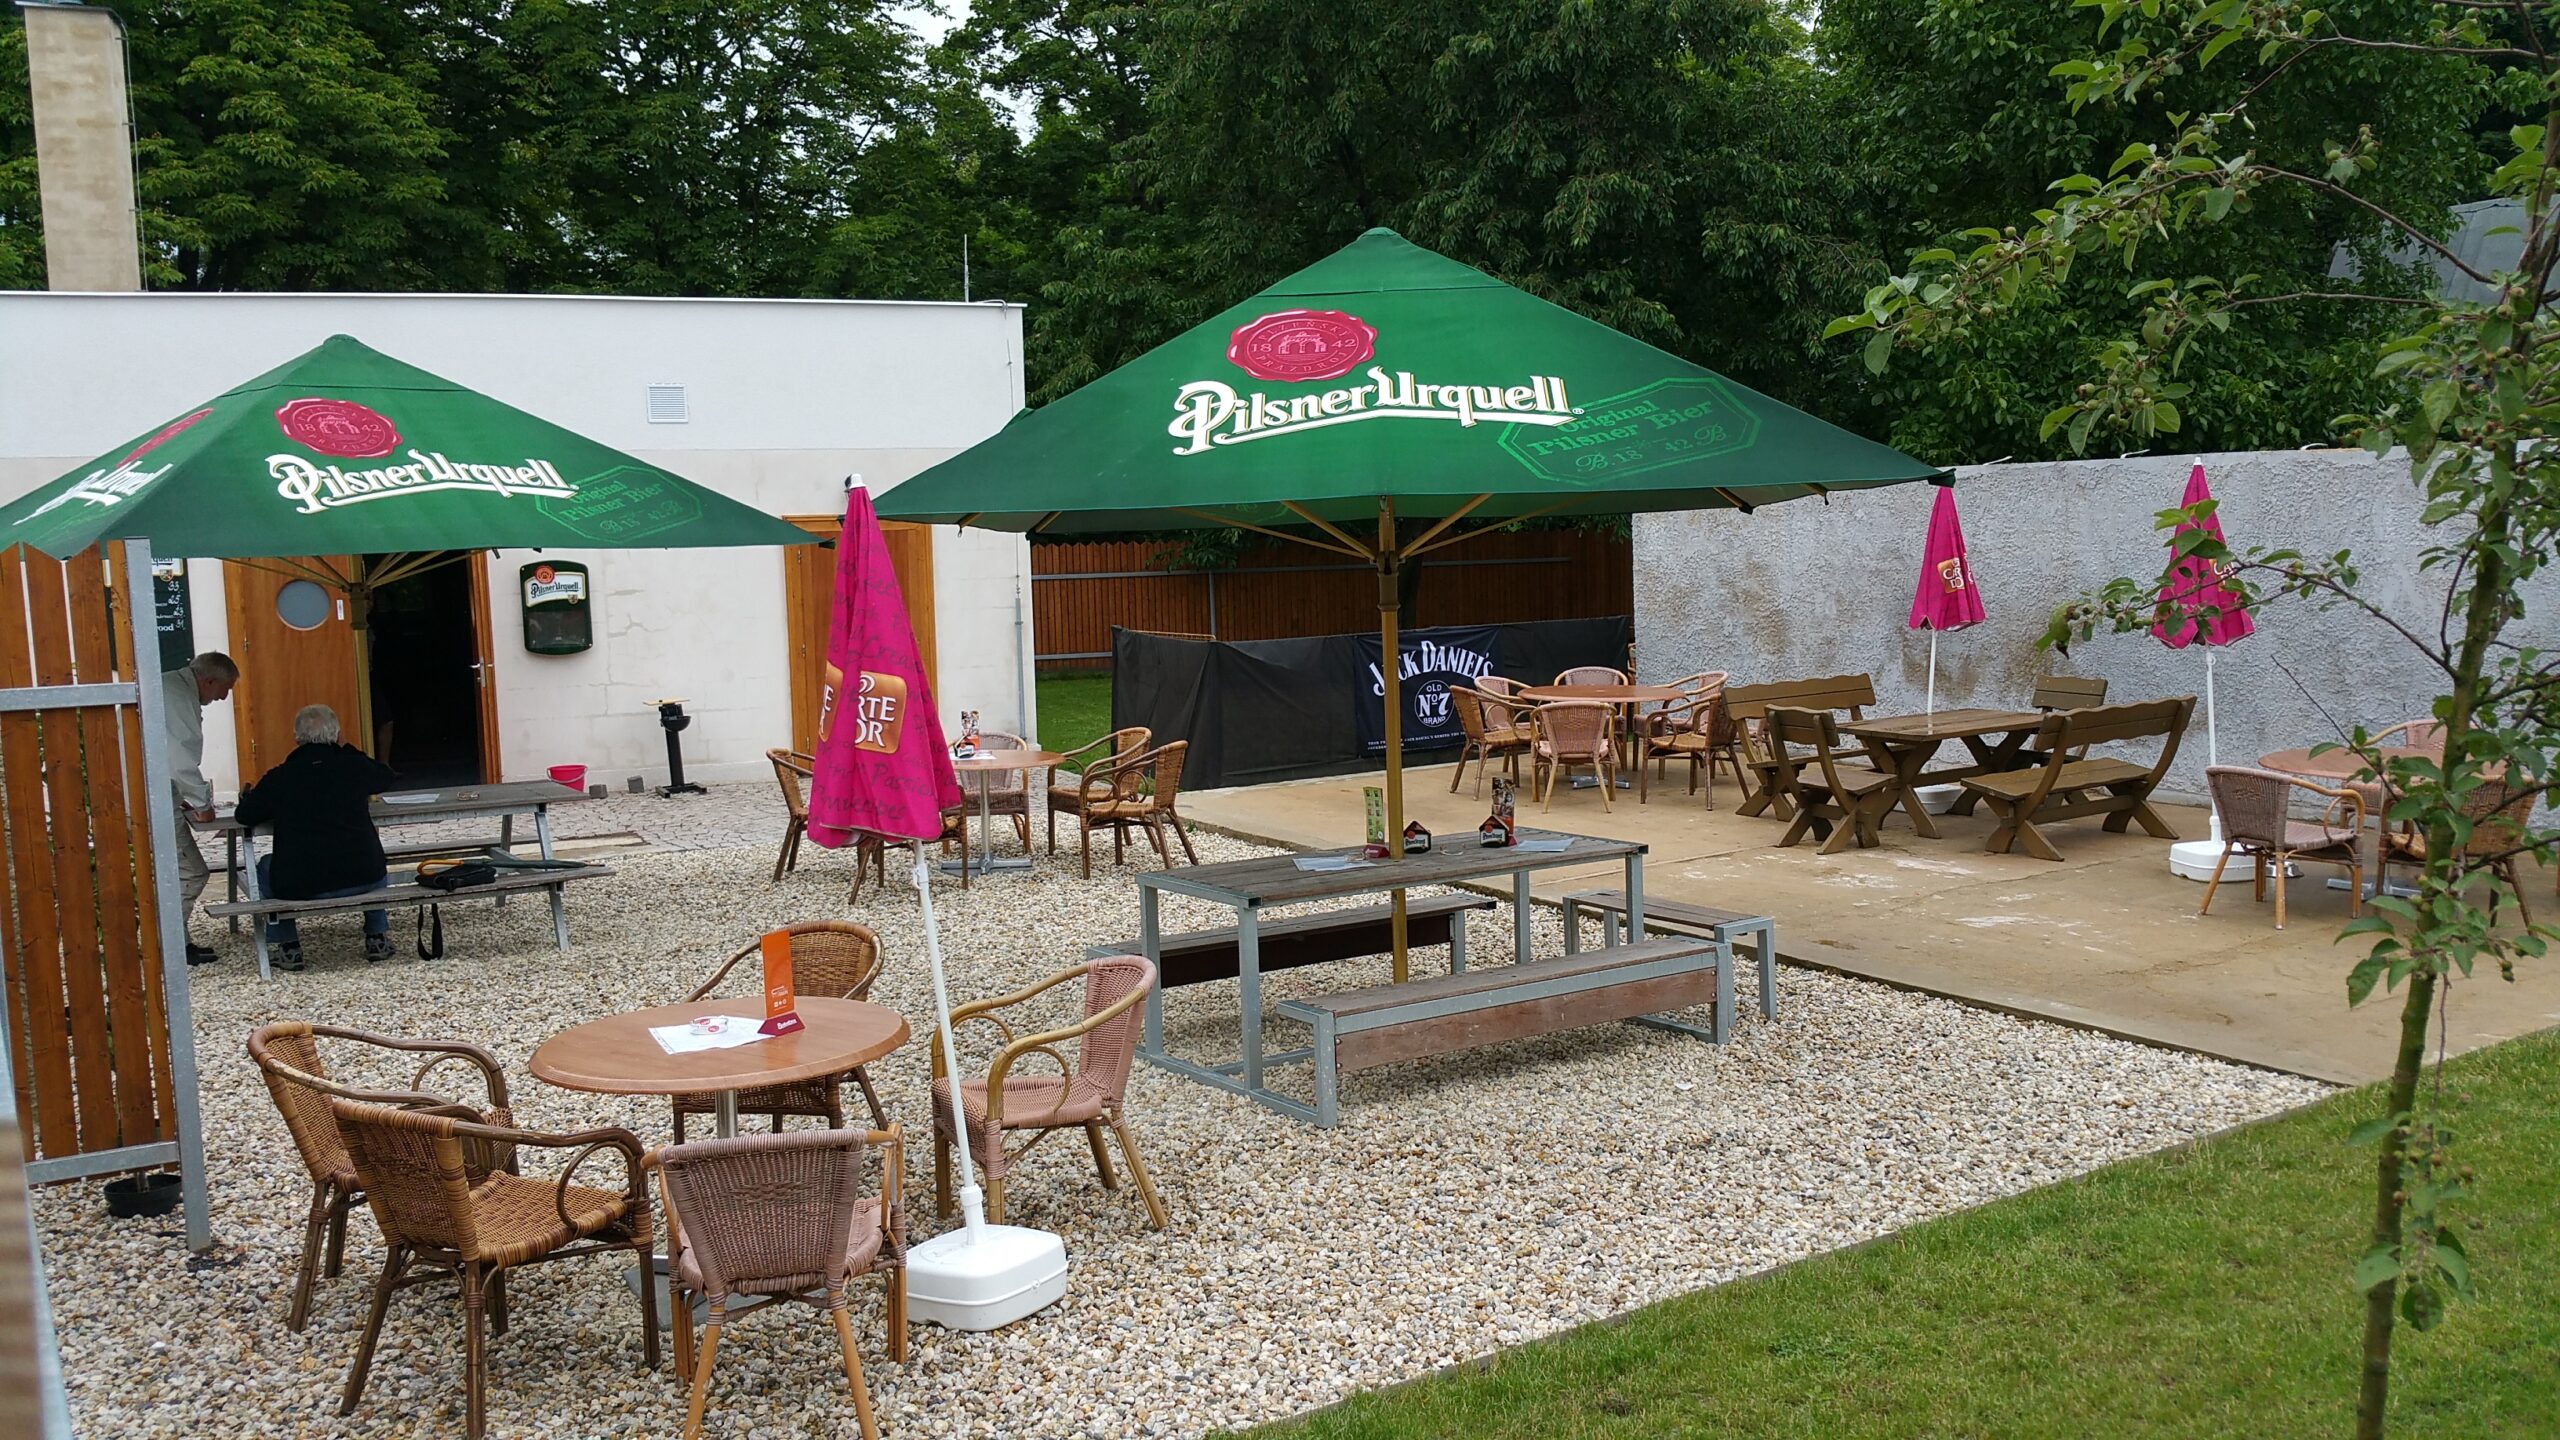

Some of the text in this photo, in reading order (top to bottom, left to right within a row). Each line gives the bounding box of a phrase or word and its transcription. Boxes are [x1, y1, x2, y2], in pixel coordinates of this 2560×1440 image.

[1252, 339, 1356, 352] 18 42
[1168, 366, 1571, 456] Pilsner Urquell
[1526, 400, 1714, 456] Pilsner Bier
[1556, 399, 1661, 434] Original
[264, 449, 571, 515] Pilsner Urquell
[560, 483, 665, 522] Pilsner Bier
[1369, 650, 1421, 697] JCK
[1426, 683, 1443, 692] OLD
[1423, 716, 1446, 725] BRAND
